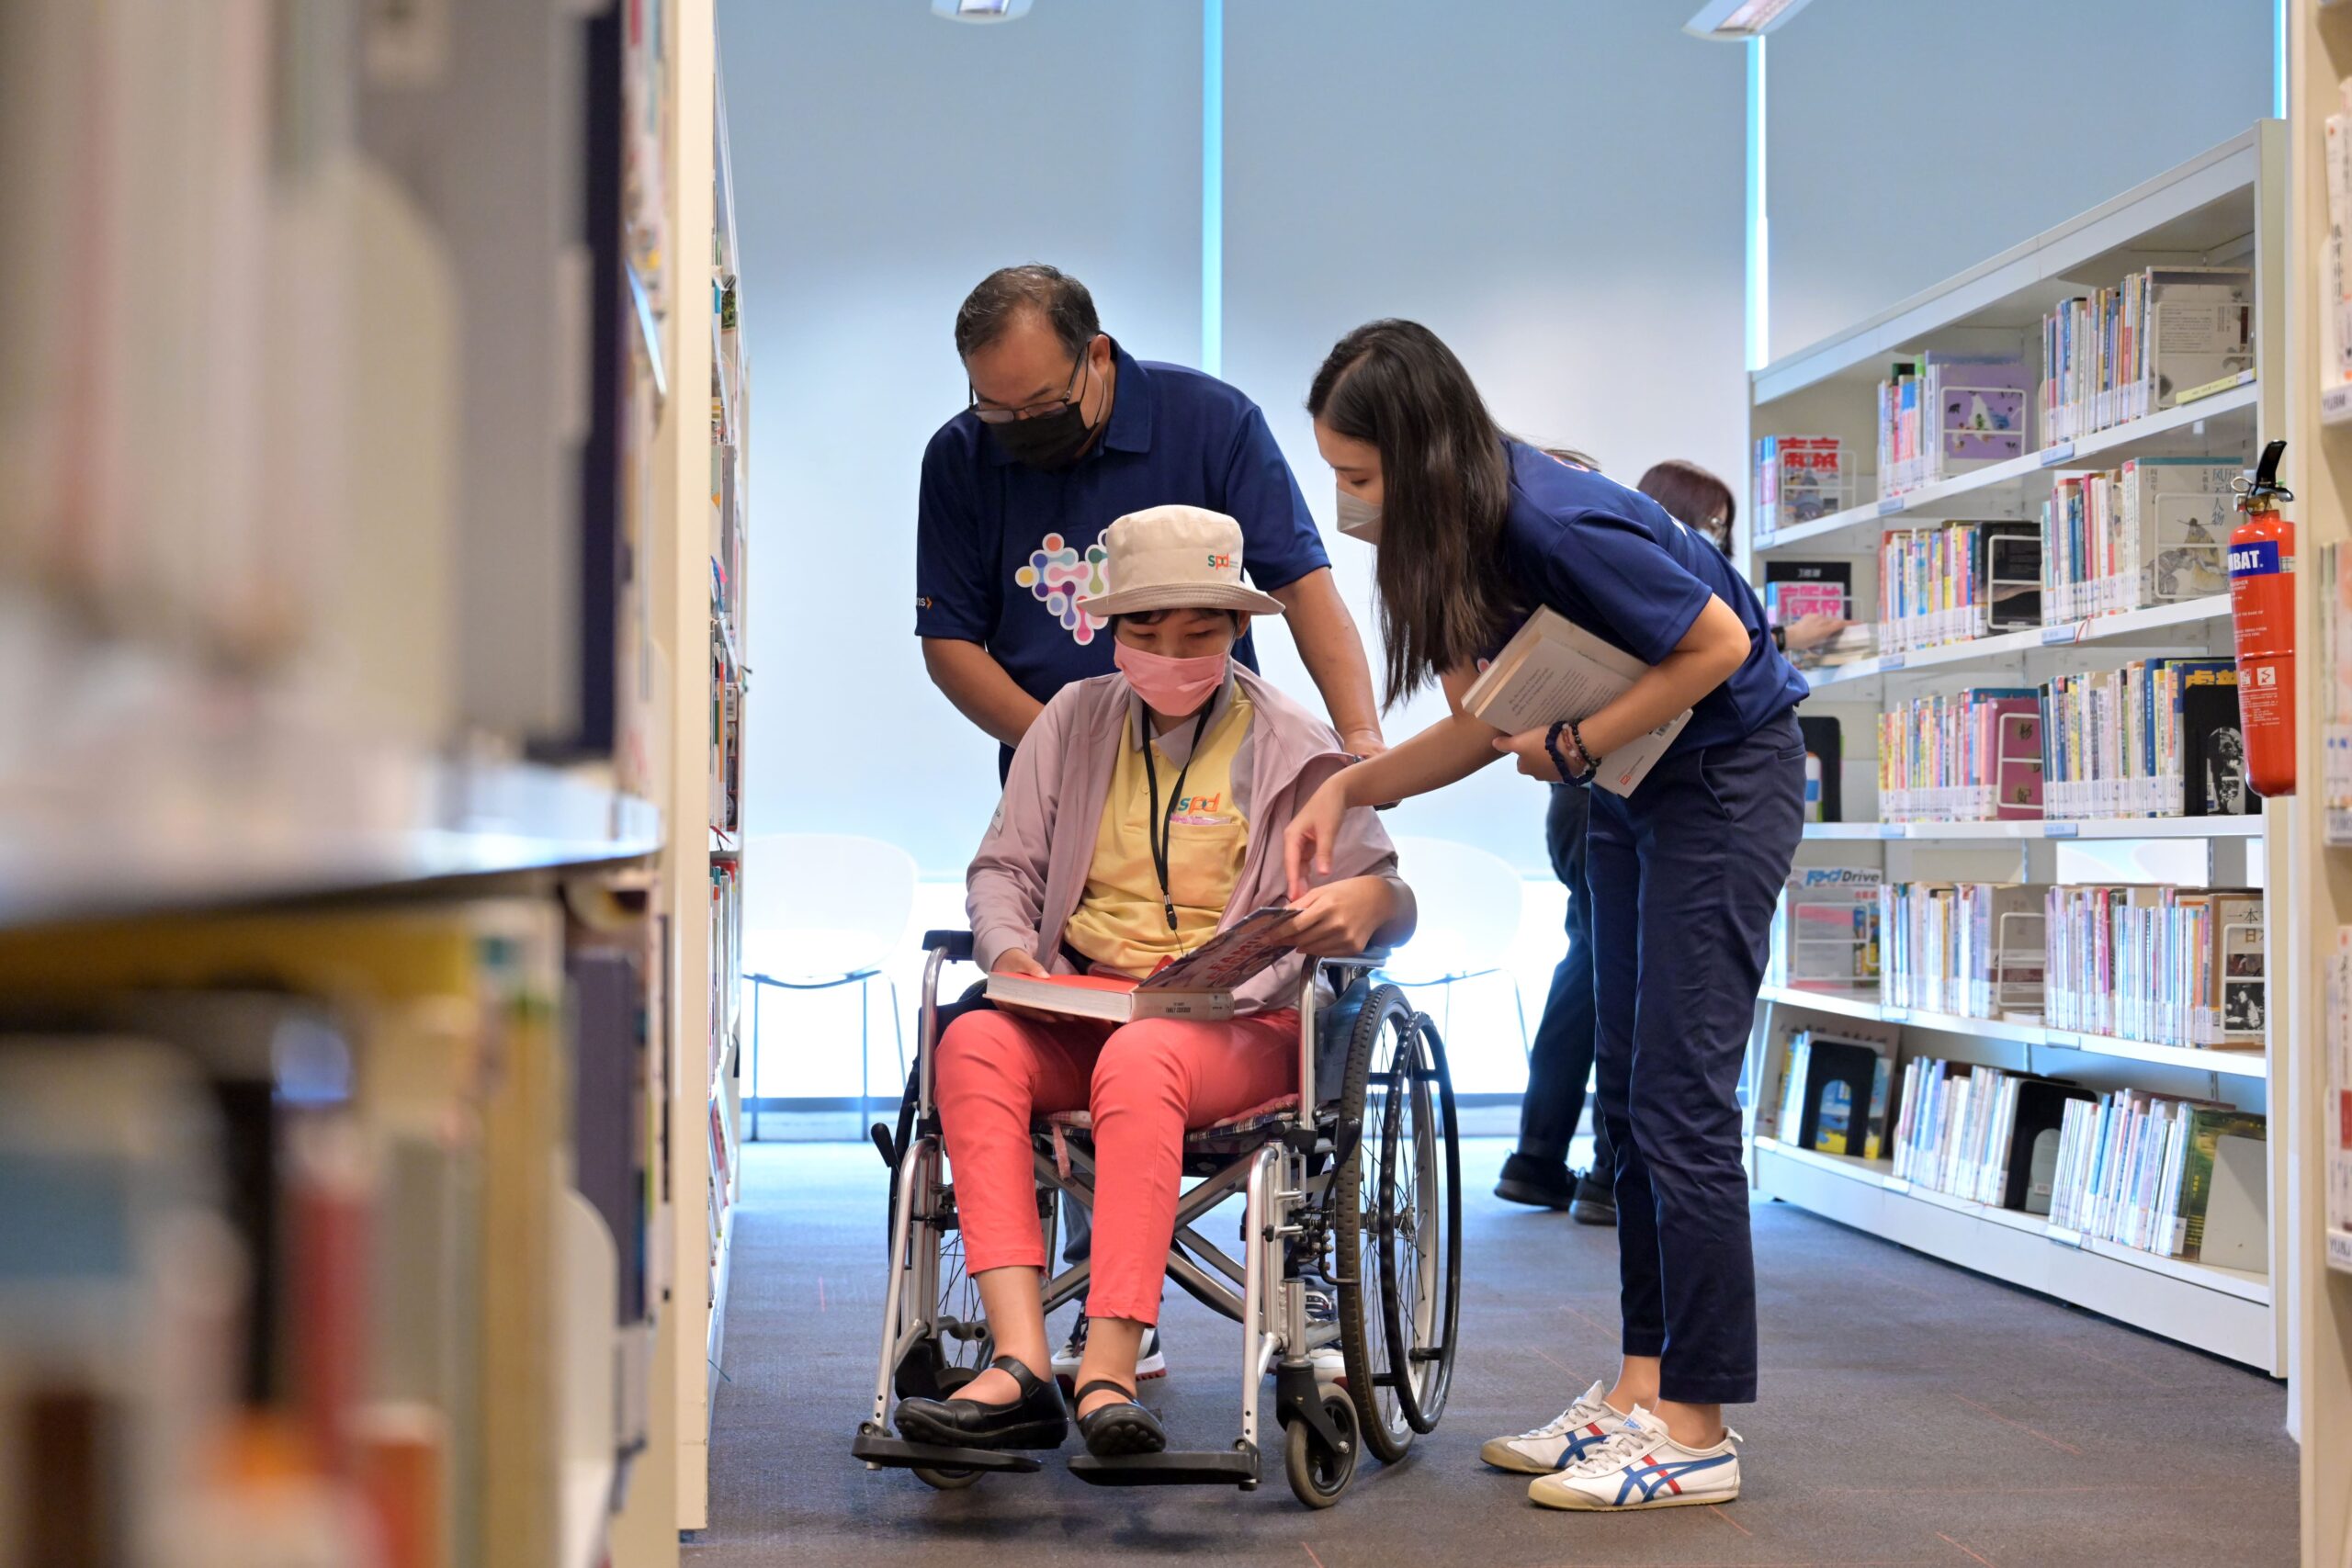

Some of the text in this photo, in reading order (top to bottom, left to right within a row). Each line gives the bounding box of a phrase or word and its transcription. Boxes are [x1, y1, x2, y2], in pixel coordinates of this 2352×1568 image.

[1207, 552, 1230, 570] spd
[1178, 792, 1221, 815] spd
[1842, 869, 1880, 883] Drive
[2227, 908, 2264, 924] 一本
